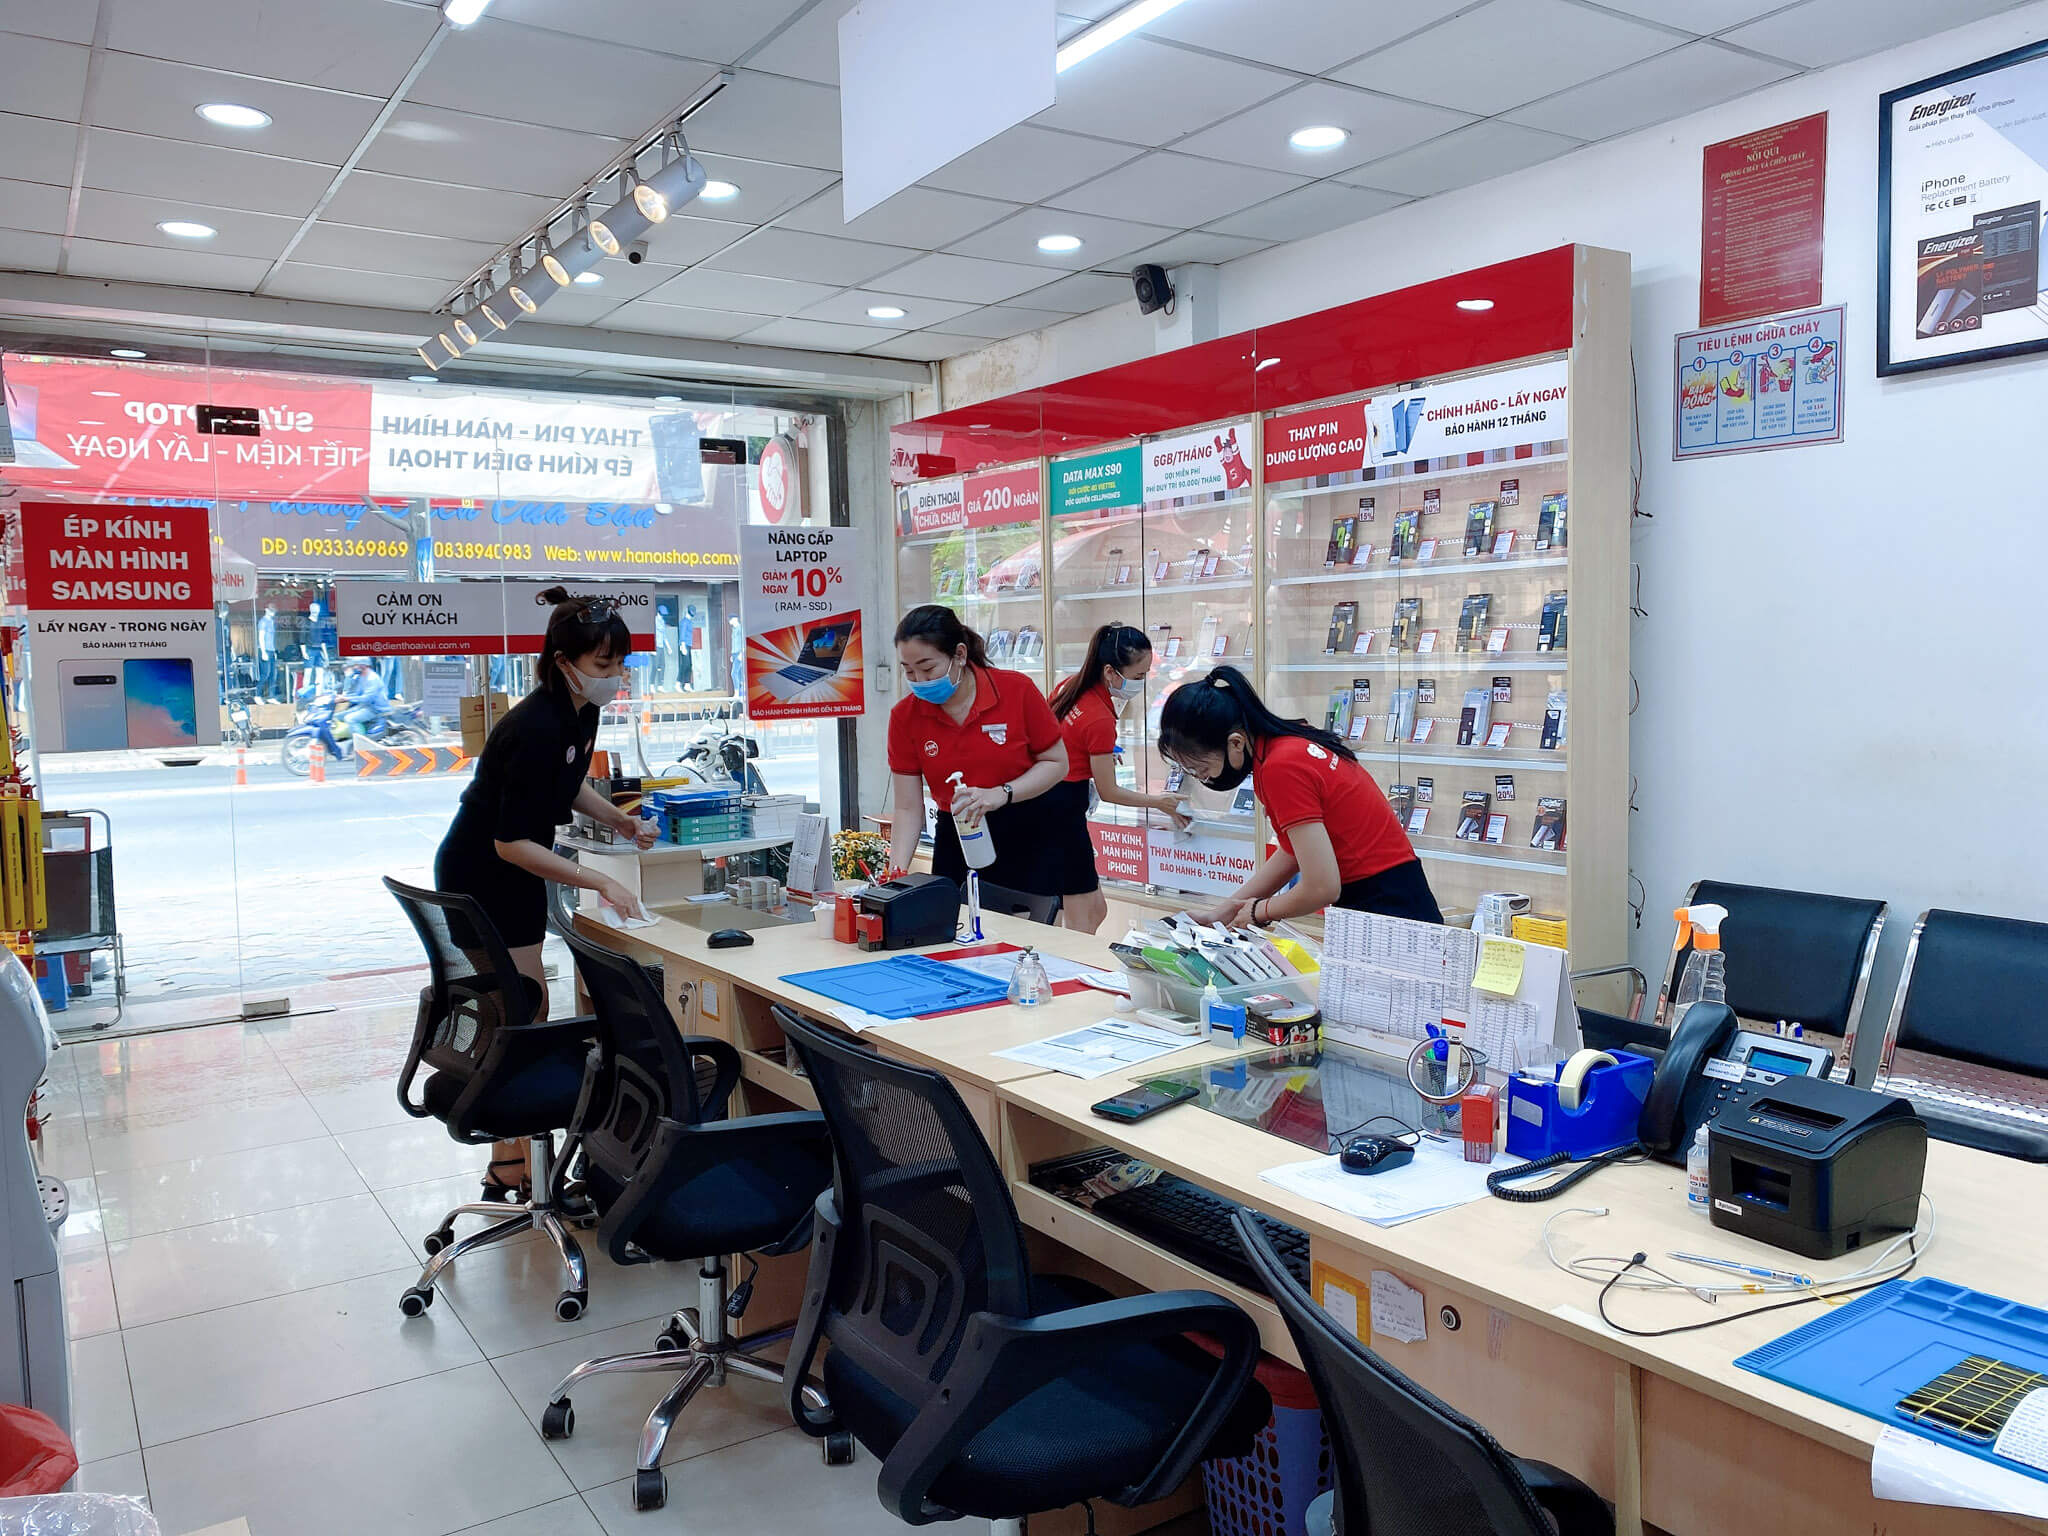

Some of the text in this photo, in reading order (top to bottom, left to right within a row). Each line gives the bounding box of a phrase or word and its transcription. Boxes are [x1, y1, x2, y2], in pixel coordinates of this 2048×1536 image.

[1909, 92, 1976, 122] Energizer
[1921, 173, 1966, 193] iPhone
[1921, 174, 2011, 202] Replacement Battery
[1923, 233, 1978, 255] Energizer
[1697, 337, 1721, 353] TIÊU
[1724, 332, 1752, 349] LỆNH
[1789, 320, 1821, 336] CHÁY
[1811, 338, 1820, 349] 4
[1733, 352, 1741, 363] 2
[1772, 346, 1779, 357] 3
[1697, 358, 1703, 369] 1
[1426, 386, 1567, 422] CHÍNH HÃNG LẤY NGAY
[1445, 410, 1546, 437] BẢO HÀNH 12 THÁNG
[1288, 421, 1338, 443] THAY PIN
[1153, 444, 1213, 467] 6GB/THÁNG
[1266, 437, 1363, 466] DUNG LƯỢNG CAO
[1063, 462, 1122, 484] DATA MAX S90
[967, 486, 1038, 514] GIÁ 200 NGÀN
[1501, 495, 1518, 506] 20%
[1359, 512, 1374, 522] 15%
[1424, 504, 1440, 514] 10%
[64, 513, 172, 539] ÉP KÍNH
[768, 530, 834, 545] NÂNG CẤP
[261, 538, 287, 556] DĐ
[302, 537, 409, 559] 0933369869
[544, 545, 581, 563] Web:
[776, 550, 827, 562] LAPTOP
[50, 545, 188, 570] MÀN HÌNH
[762, 568, 788, 581] GIẢM
[791, 566, 842, 597] 10%
[52, 580, 191, 601] SAMSUNG
[762, 584, 788, 594] NGAY
[376, 591, 442, 607] CẢM ƠN
[612, 591, 649, 607] ÒNG
[38, 618, 207, 633] LẤY NGAY TRONG NGÀY
[362, 610, 458, 627] QUÝ KHÁCH
[351, 640, 470, 652] cskh@dienthoaivui.com.vn
[1355, 692, 1369, 701] 10%
[1419, 694, 1434, 703] 10%
[1494, 692, 1511, 701] 10%
[1418, 791, 1432, 801] 20%
[1498, 790, 1515, 800] 20%
[1100, 830, 1144, 848] THAY KÍNH,
[1102, 844, 1142, 861] MÀN HÌNH
[1150, 845, 1255, 872] THAY NHANH, LẤY NGAY
[1107, 860, 1138, 876] iPHONE
[1197, 869, 1202, 878] 6
[1208, 870, 1216, 880] 12
